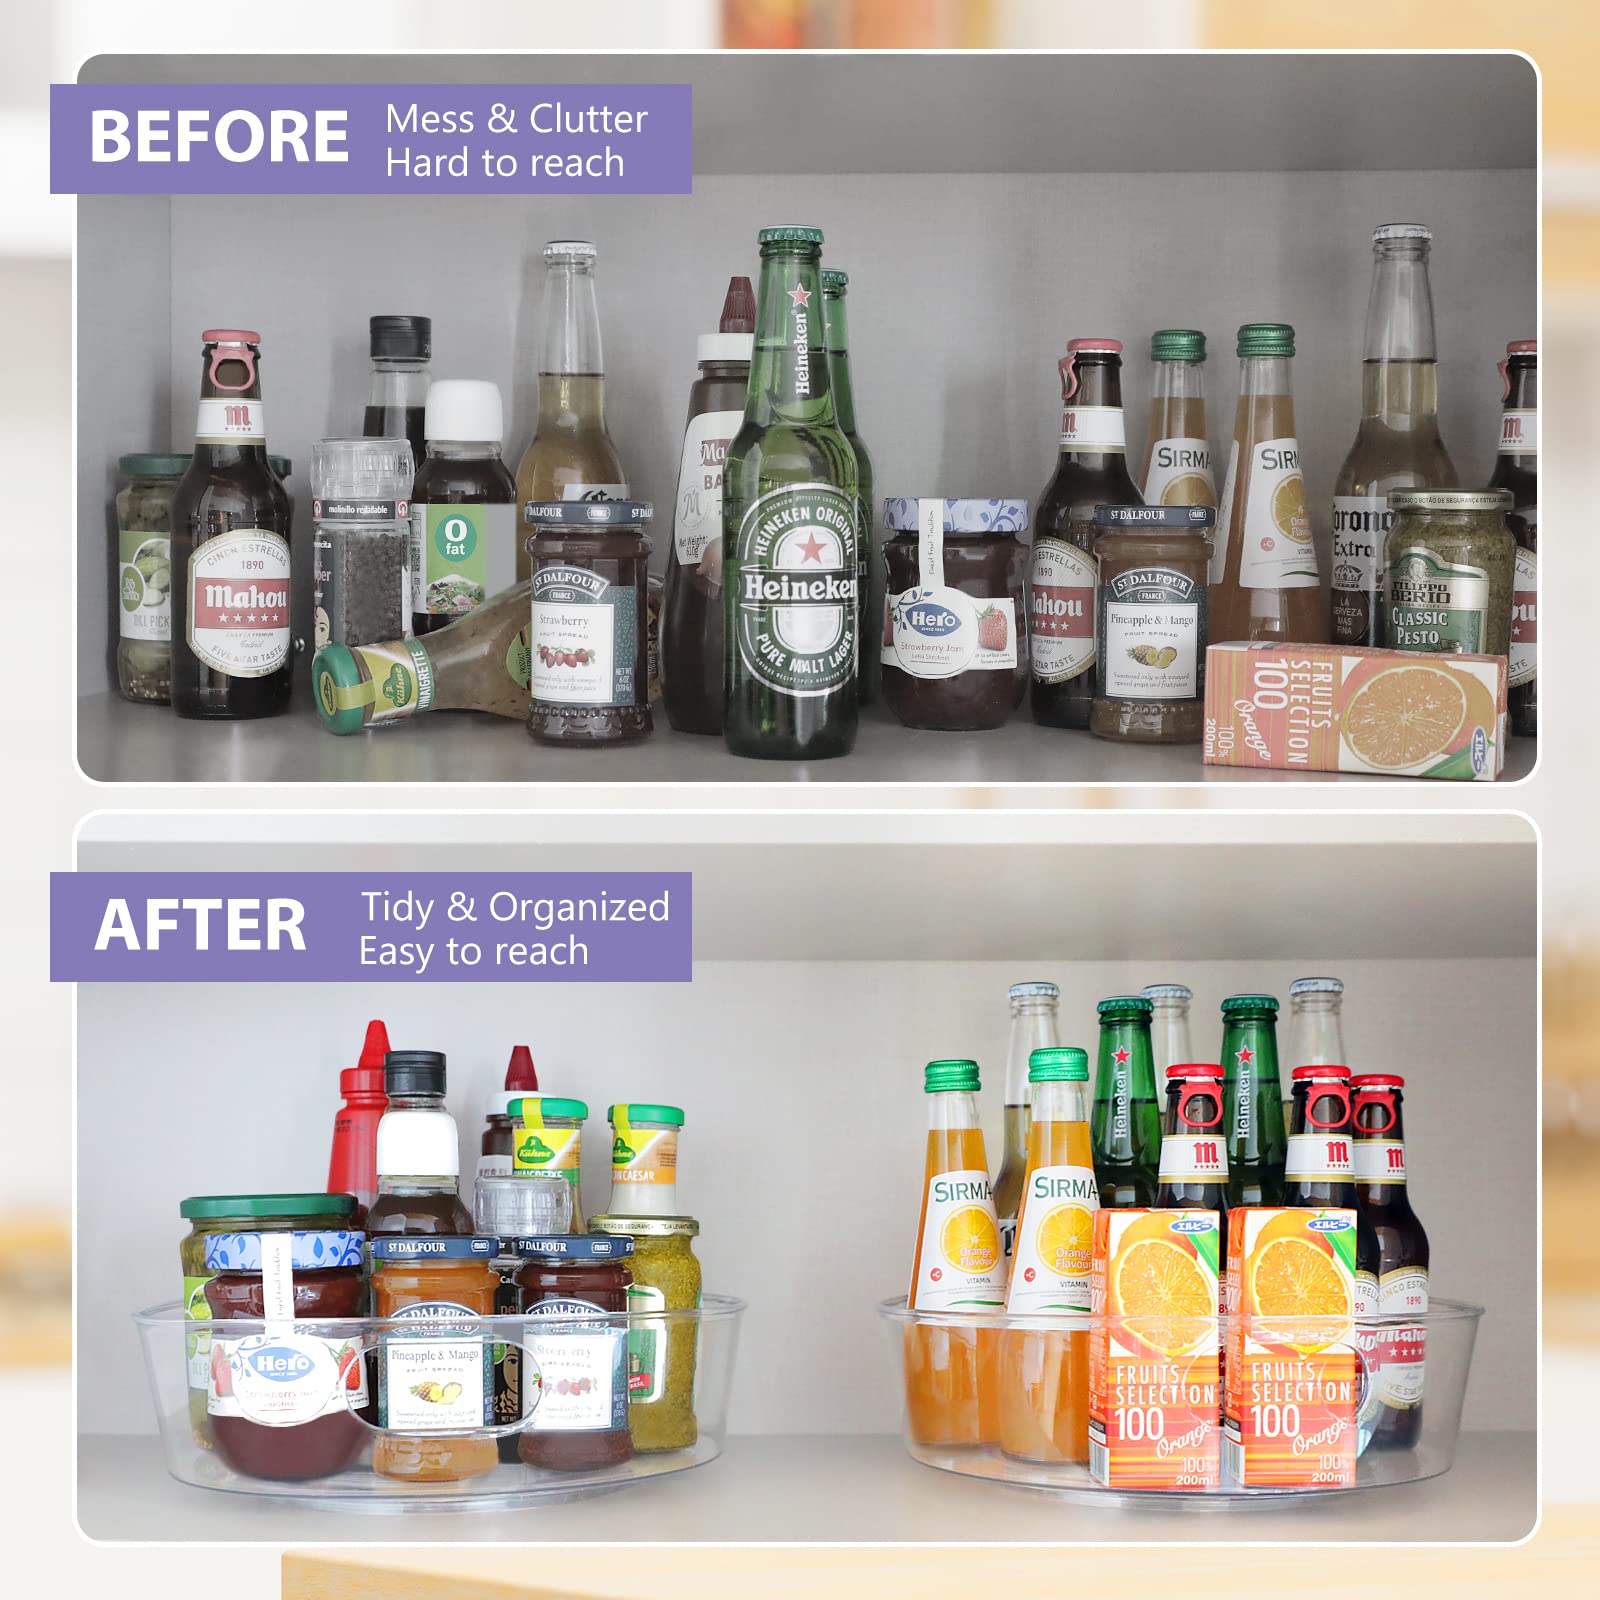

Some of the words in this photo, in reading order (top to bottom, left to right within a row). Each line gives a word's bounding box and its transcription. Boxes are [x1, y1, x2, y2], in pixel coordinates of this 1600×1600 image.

[794, 312, 810, 395] Heineken
[1120, 510, 1165, 520] DALFOUR
[754, 506, 810, 556] HEINEKEN
[816, 506, 854, 556] ORIGINAL
[243, 544, 287, 567] ESTRELLAS
[446, 543, 466, 555] fat
[241, 560, 264, 570] 1890
[1037, 551, 1082, 577] ESTRELLAS
[543, 572, 600, 591] DALFOUR
[1130, 573, 1188, 591] DALFOUR
[204, 585, 287, 608] Mahou
[1391, 591, 1451, 604] BERIO
[539, 614, 589, 629] Strawberry
[912, 611, 956, 627] Hero
[1111, 613, 1153, 627] Pineapple
[1154, 615, 1162, 625] &
[1333, 608, 1363, 617] ERVEZA
[1392, 606, 1448, 626] CLASSIC
[1397, 626, 1440, 645] PESTO
[260, 644, 283, 662] TASTE
[756, 633, 786, 667] PURE
[789, 658, 825, 674] MALT
[829, 631, 853, 668] LAGER
[901, 642, 944, 653] Strawberry
[1050, 653, 1075, 670] TASTE
[411, 650, 431, 709] VINAIGRETTE
[1253, 658, 1289, 710] 100
[1311, 662, 1333, 729] FRUITS
[1287, 660, 1311, 764] SELECTION
[1205, 718, 1217, 758] 200ml
[1233, 699, 1272, 761] Orange
[1114, 1070, 1127, 1139] Heineken
[1237, 1070, 1250, 1139] Heineken
[518, 1149, 551, 1159] Kühne
[612, 1150, 634, 1159] ühne
[622, 1169, 655, 1182] CAESAR
[398, 1242, 446, 1253] DALFOUR
[525, 1242, 567, 1252] DALFOUR
[959, 1246, 992, 1258] Orange
[1055, 1247, 1091, 1261] Orange
[959, 1257, 993, 1267] Flavour
[965, 1277, 991, 1285] VITAMIN
[1060, 1280, 1088, 1289] VITAMIN
[256, 1353, 310, 1372] Hero
[391, 1349, 437, 1363] Pineapple
[449, 1349, 479, 1362] Mango
[1116, 1364, 1180, 1385] FRUITS
[1251, 1361, 1315, 1382] FRUITS
[1114, 1406, 1164, 1441] 100
[1250, 1403, 1300, 1438] 100
[1176, 1475, 1214, 1486] 200ml
[1311, 1471, 1350, 1483] 200ml
